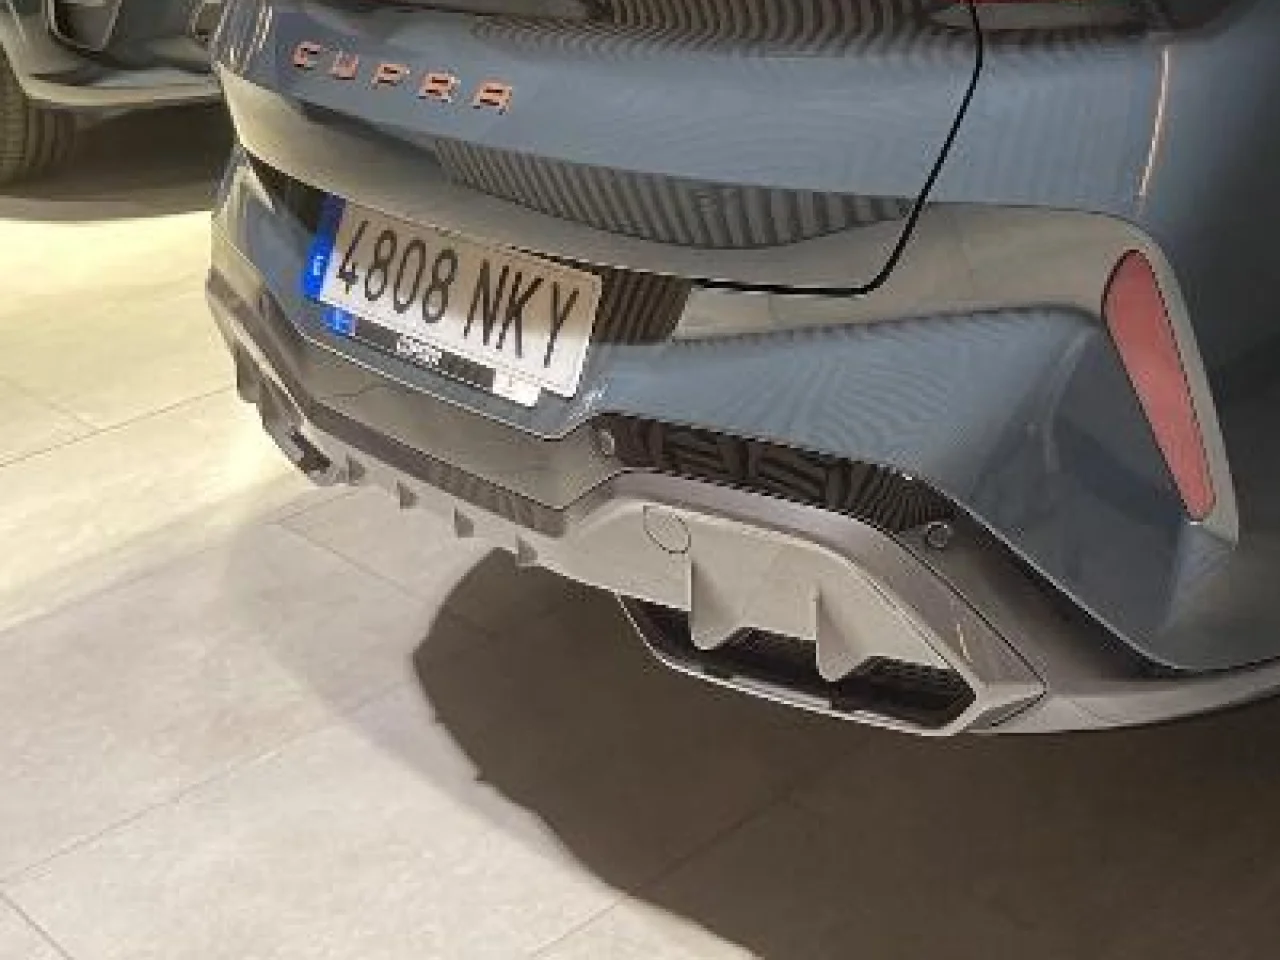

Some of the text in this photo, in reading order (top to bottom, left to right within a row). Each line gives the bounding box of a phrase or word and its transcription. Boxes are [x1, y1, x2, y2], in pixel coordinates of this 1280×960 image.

[291, 40, 514, 115] CUPRA
[336, 219, 580, 370] 4808 NKY
